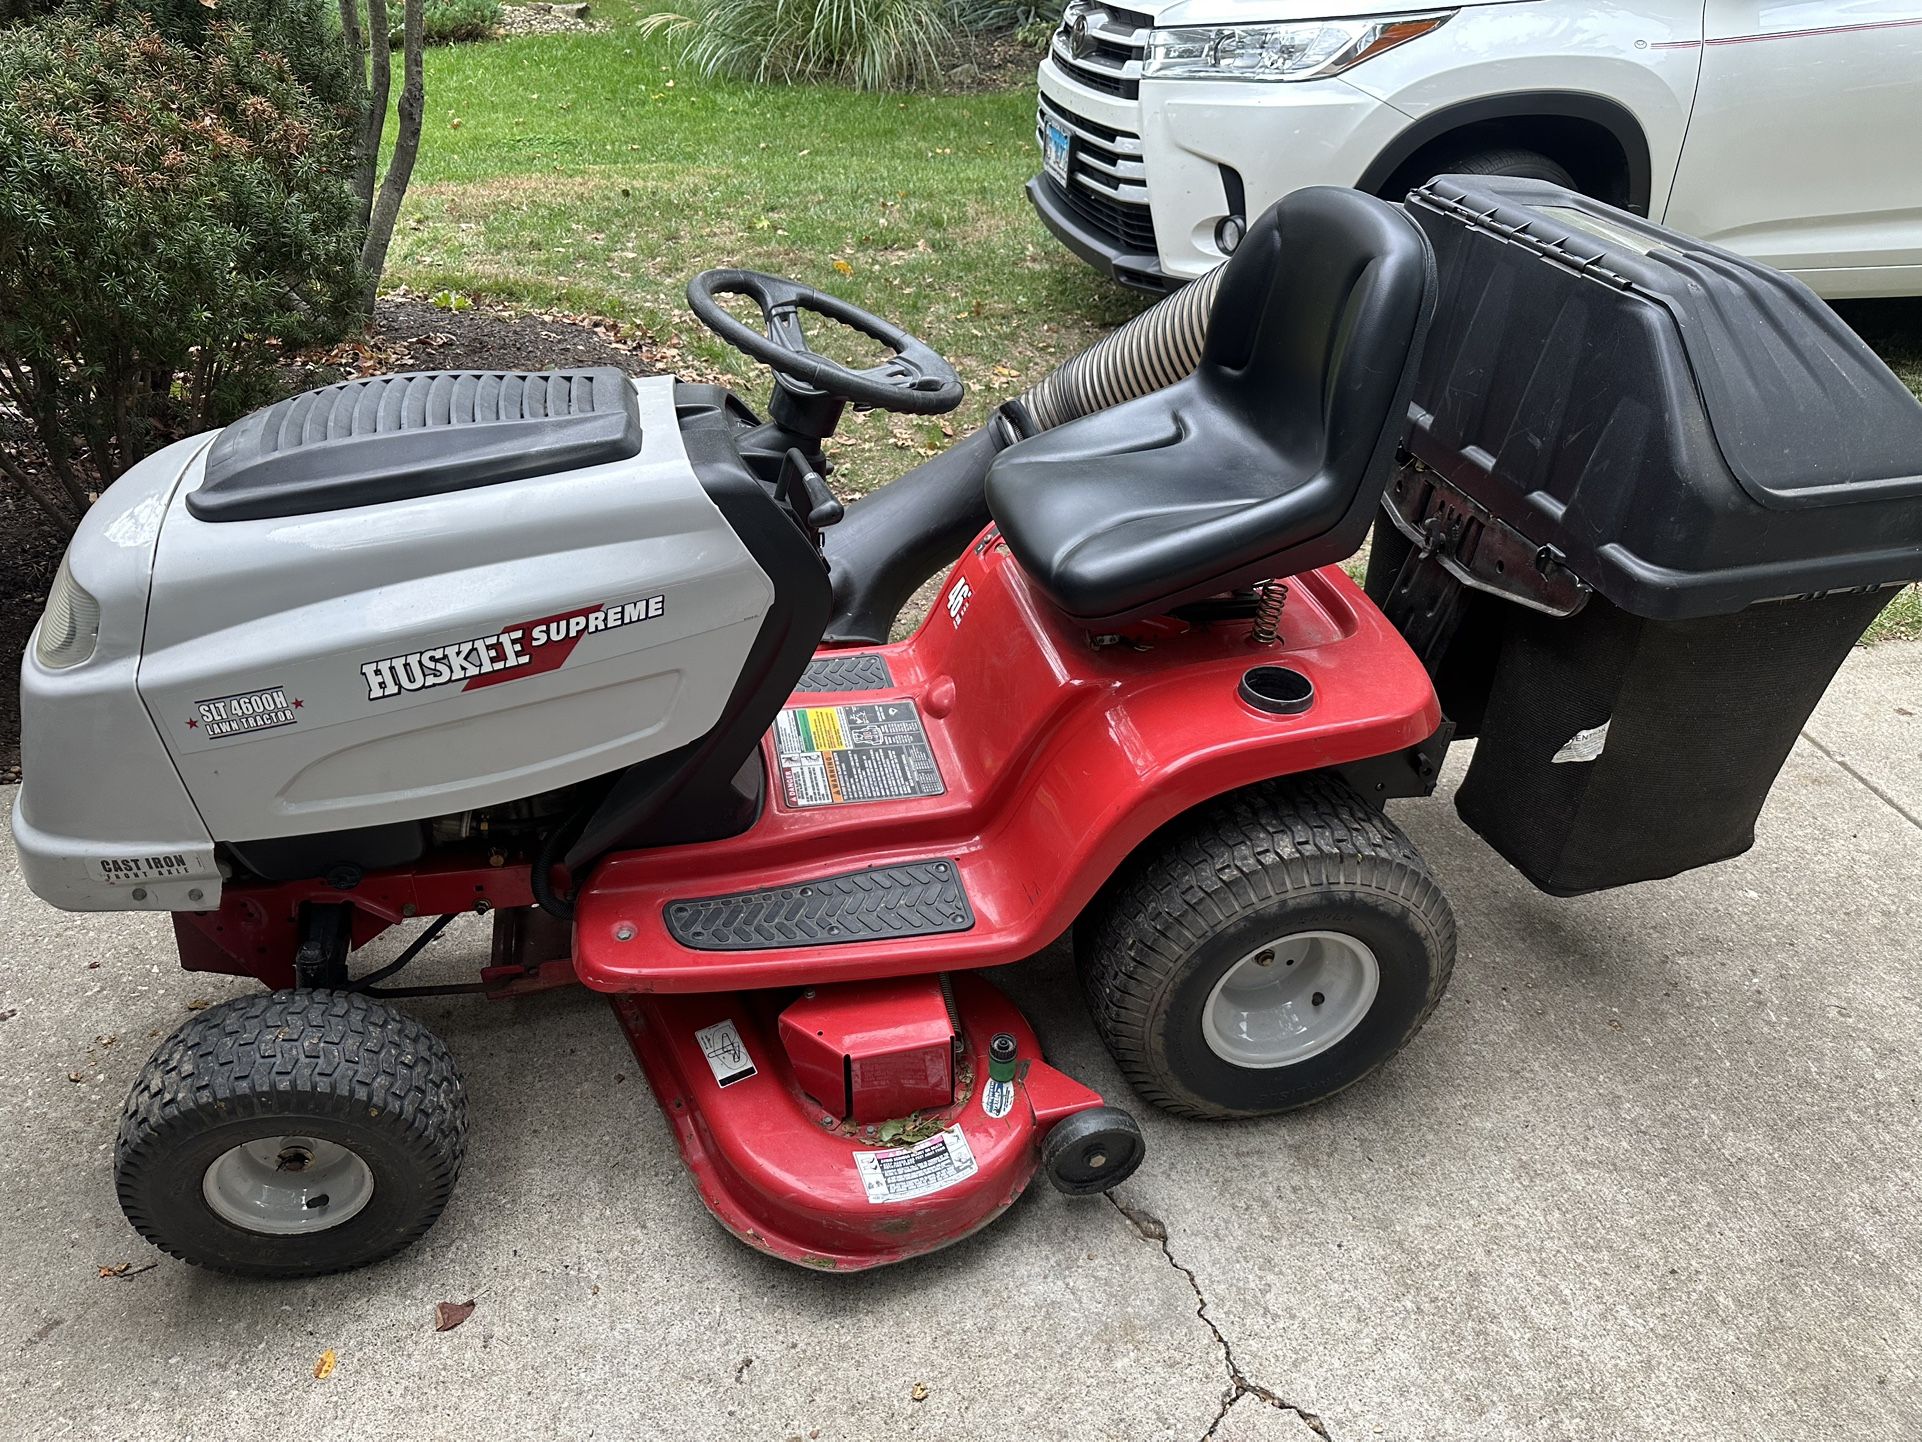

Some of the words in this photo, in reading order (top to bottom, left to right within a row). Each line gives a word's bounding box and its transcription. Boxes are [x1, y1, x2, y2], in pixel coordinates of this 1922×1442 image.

[360, 629, 531, 701] HUSKEE
[530, 594, 665, 648] SUPREME
[198, 700, 228, 722] SLT
[230, 689, 288, 717] 4600H
[205, 718, 239, 736] LAWN
[240, 708, 295, 729] TRACTOR
[784, 770, 796, 797] DANGER
[825, 756, 839, 789] WARNING
[100, 858, 142, 873] CAST
[144, 854, 187, 870] IRON
[106, 870, 148, 880] FRONT
[157, 866, 190, 877] AXLE
